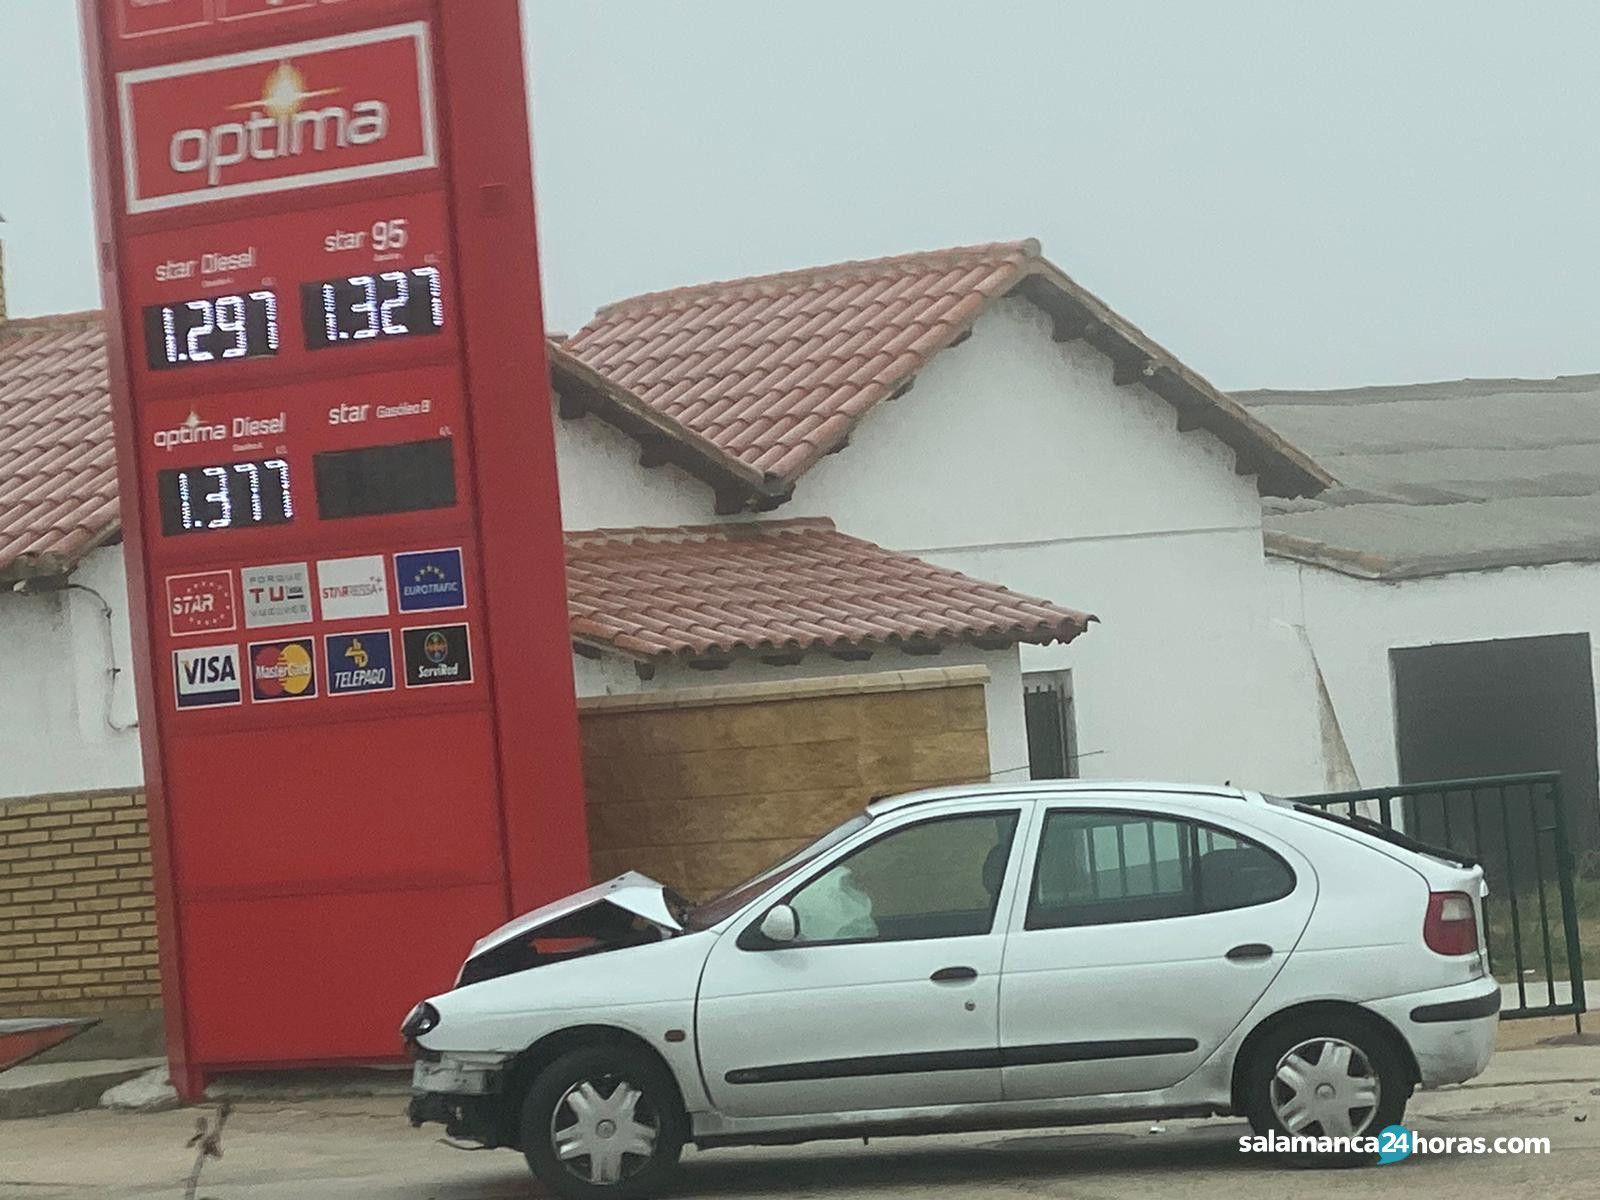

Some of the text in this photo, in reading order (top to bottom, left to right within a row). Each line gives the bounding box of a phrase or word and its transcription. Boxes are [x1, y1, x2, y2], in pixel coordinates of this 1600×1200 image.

[169, 100, 390, 186] optima
[322, 219, 408, 252] star 95
[155, 247, 256, 281] star Diesel
[322, 266, 444, 341] 1.327
[162, 291, 279, 363] 1.297
[328, 403, 369, 425] star
[421, 399, 431, 413] B
[153, 424, 226, 451] optima
[232, 412, 286, 438] Diesel
[178, 459, 293, 529] 1.377
[172, 593, 214, 615] STAR
[182, 655, 236, 685] VISA
[334, 667, 386, 689] TELEPAGO
[418, 662, 459, 679] ServiRed
